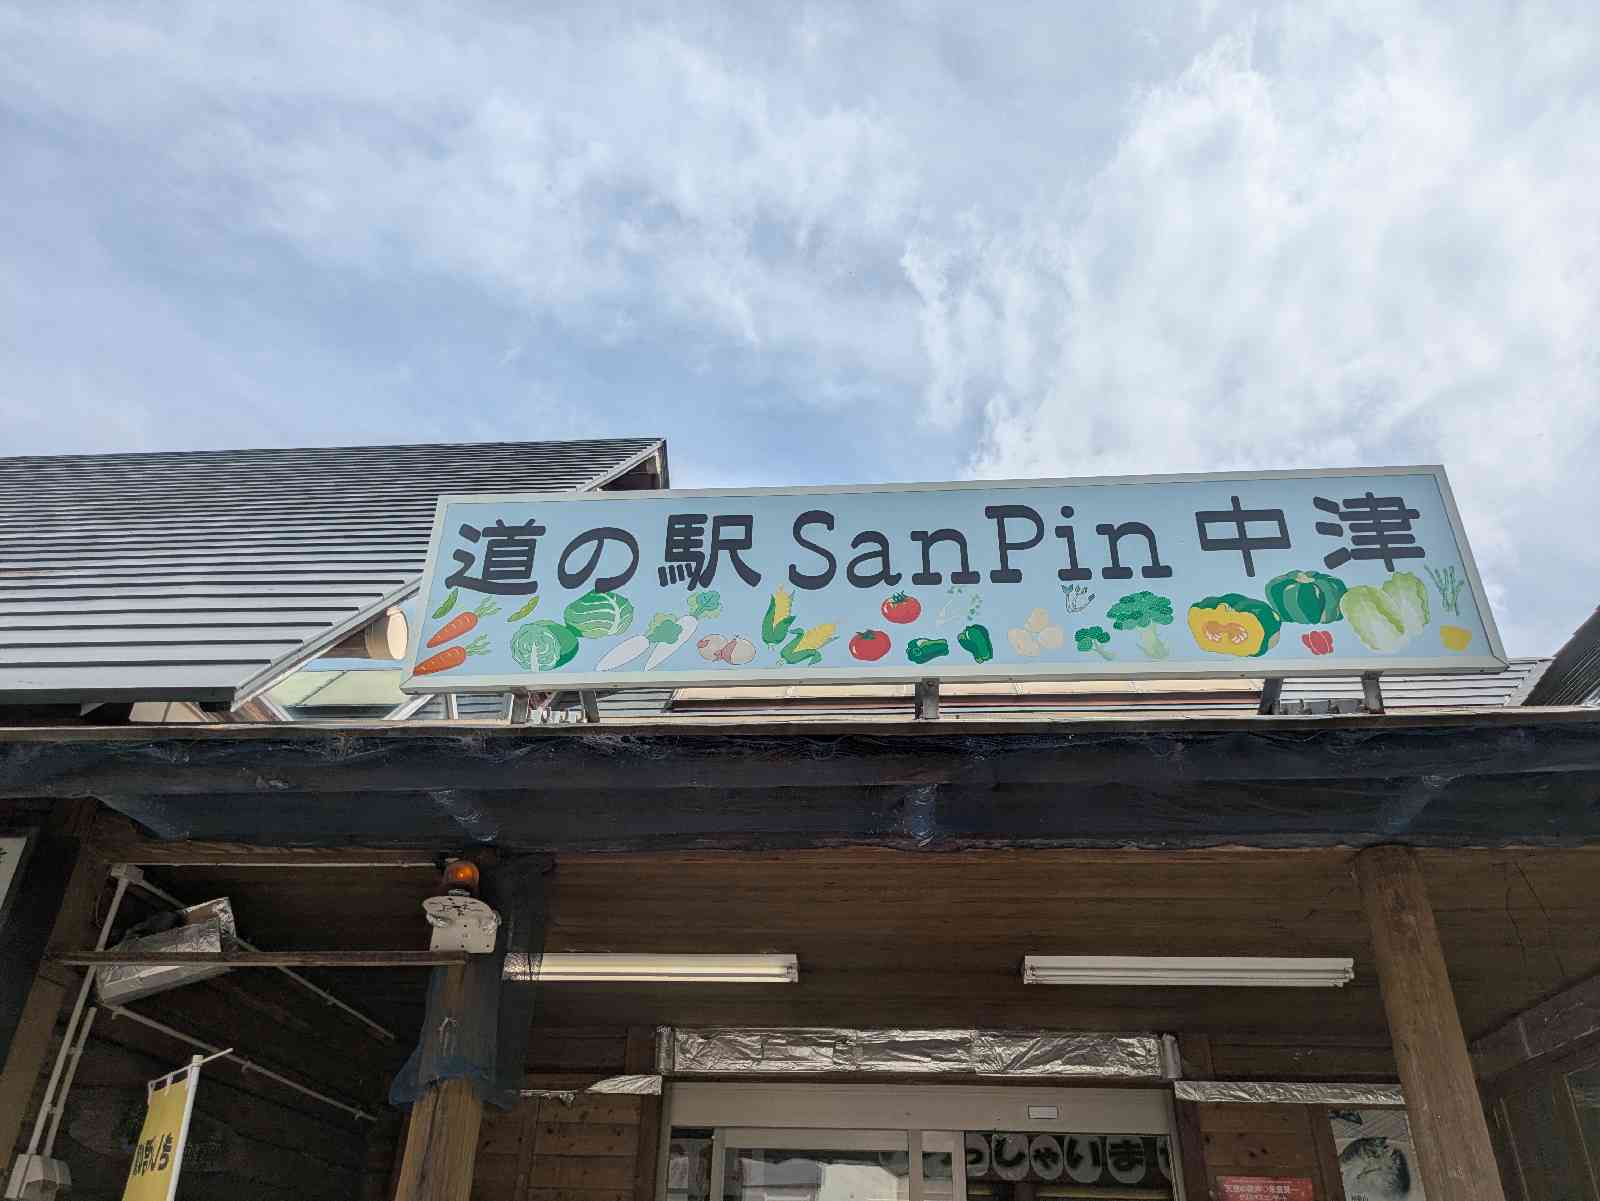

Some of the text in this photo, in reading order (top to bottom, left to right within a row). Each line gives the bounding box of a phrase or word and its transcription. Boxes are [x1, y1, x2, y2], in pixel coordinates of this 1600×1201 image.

[444, 491, 1426, 596] 道の駅 SanPin 中津
[965, 1136, 1169, 1174] っしゃいま
